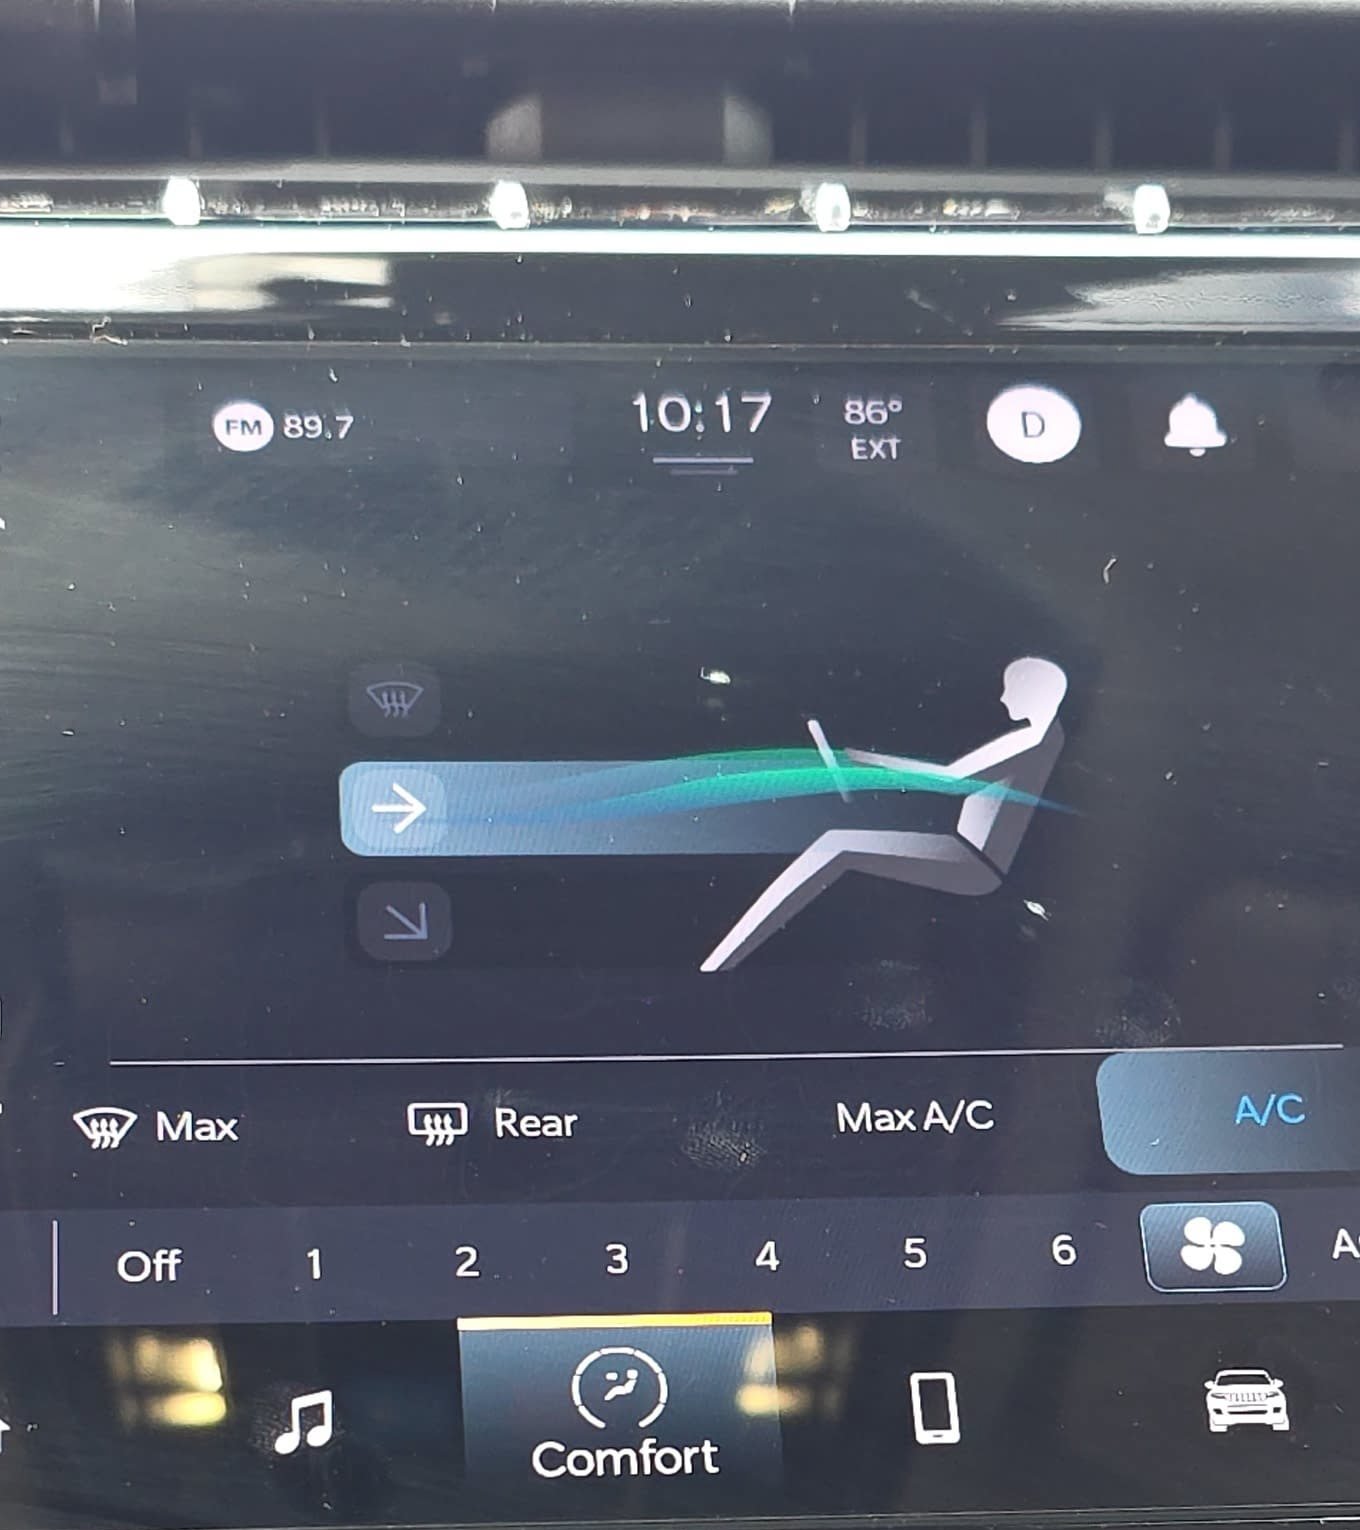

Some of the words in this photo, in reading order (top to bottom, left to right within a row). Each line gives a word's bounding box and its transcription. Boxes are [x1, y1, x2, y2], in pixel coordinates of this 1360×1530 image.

[224, 417, 263, 436] FM
[283, 414, 354, 439] 89.7
[632, 392, 772, 433] 10:17
[1020, 410, 1046, 438] D
[851, 436, 902, 460] EXT
[156, 1111, 240, 1142] Max
[495, 1107, 578, 1139] Rear
[837, 1101, 917, 1133] Max
[923, 1099, 995, 1134] A/C
[1235, 1094, 1306, 1127] A/C
[117, 1248, 183, 1283] Off
[307, 1248, 322, 1280] 1
[455, 1246, 481, 1278] 2
[605, 1243, 629, 1275] 3
[755, 1240, 781, 1272] 4
[903, 1237, 928, 1269] 5
[1052, 1233, 1078, 1266] 6
[532, 1438, 720, 1478] Comfort
